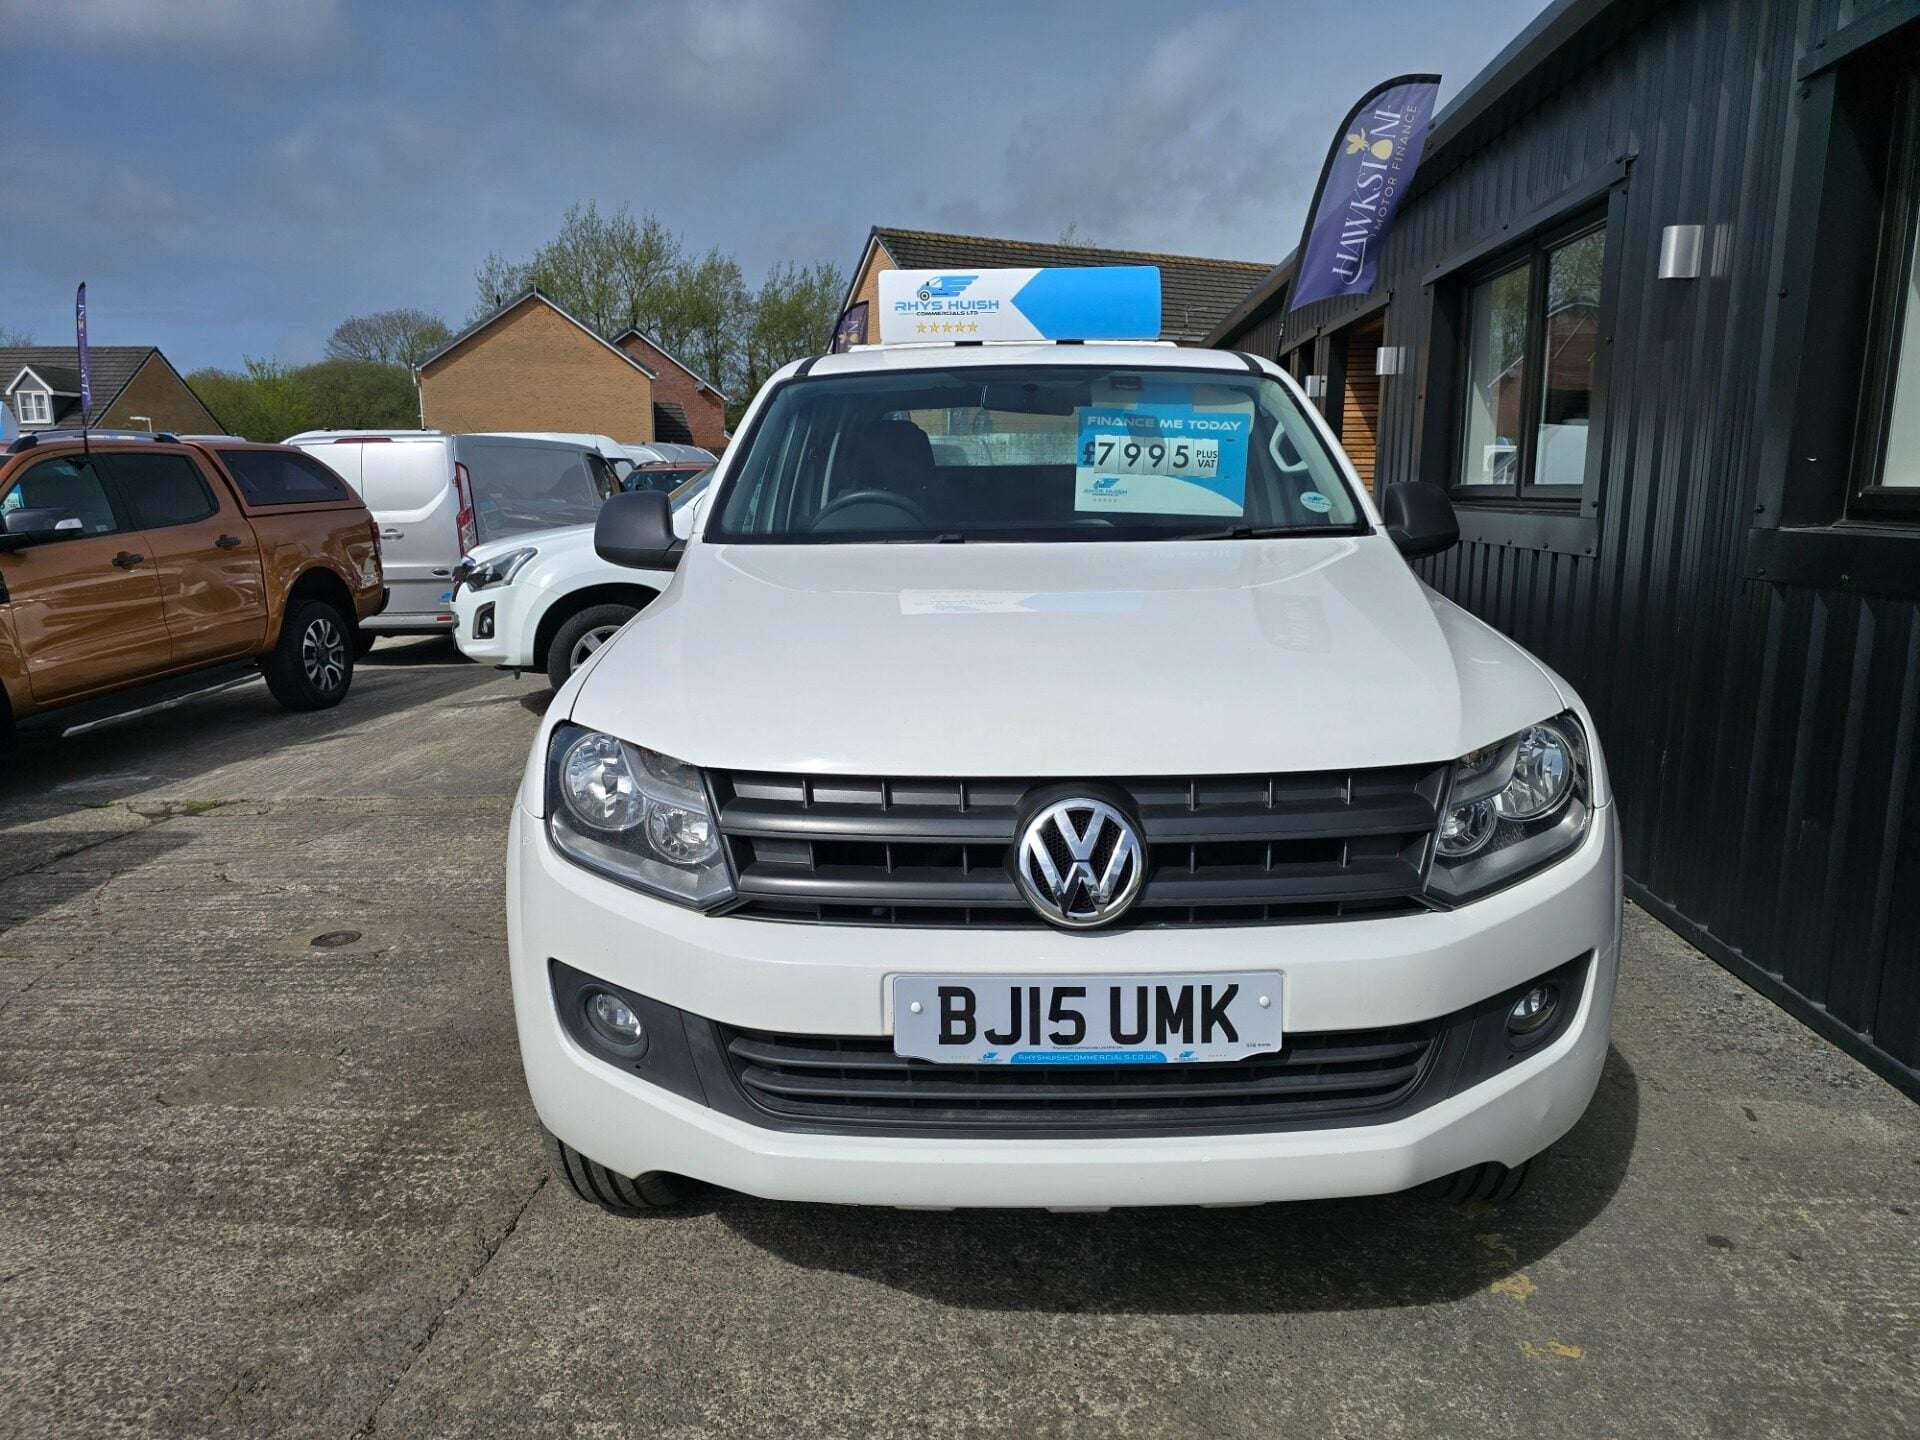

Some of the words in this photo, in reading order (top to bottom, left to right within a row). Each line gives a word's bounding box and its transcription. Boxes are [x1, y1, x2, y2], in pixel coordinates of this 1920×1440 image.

[1374, 178, 1398, 231] MOTOR
[1391, 104, 1418, 170] FINANCE
[895, 301, 942, 311] RHYS
[948, 300, 999, 310] HUISH
[1087, 416, 1155, 428] FINANCE
[1159, 419, 1184, 429] ME
[1188, 420, 1241, 431] TODAY
[1196, 450, 1218, 459] PLUS
[1198, 459, 1216, 468] VAT
[938, 986, 1086, 1046] BJ15
[1110, 983, 1239, 1045] UMK
